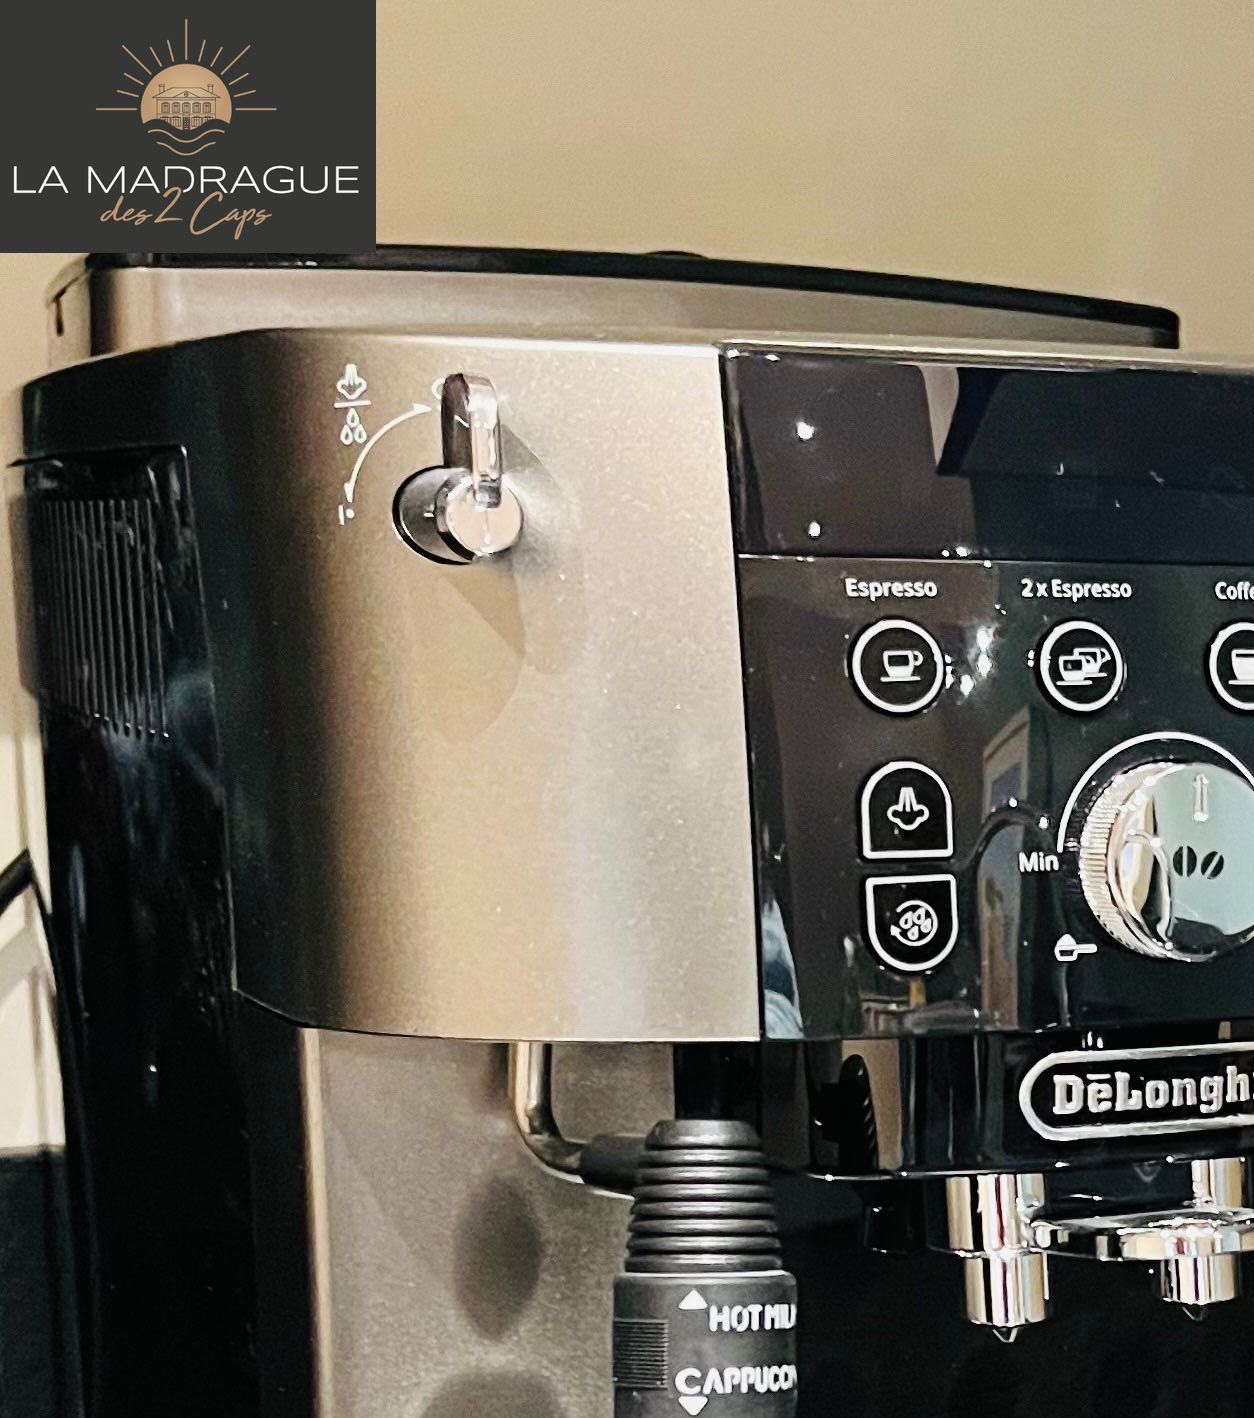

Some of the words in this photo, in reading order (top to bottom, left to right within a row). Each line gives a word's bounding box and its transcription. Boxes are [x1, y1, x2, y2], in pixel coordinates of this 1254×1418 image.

[844, 577, 938, 602] Espresso
[1020, 577, 1034, 598] 2
[1035, 581, 1049, 598] x
[1051, 578, 1132, 602] Espresso
[1018, 850, 1059, 874] Min
[708, 1303, 763, 1332] HOT
